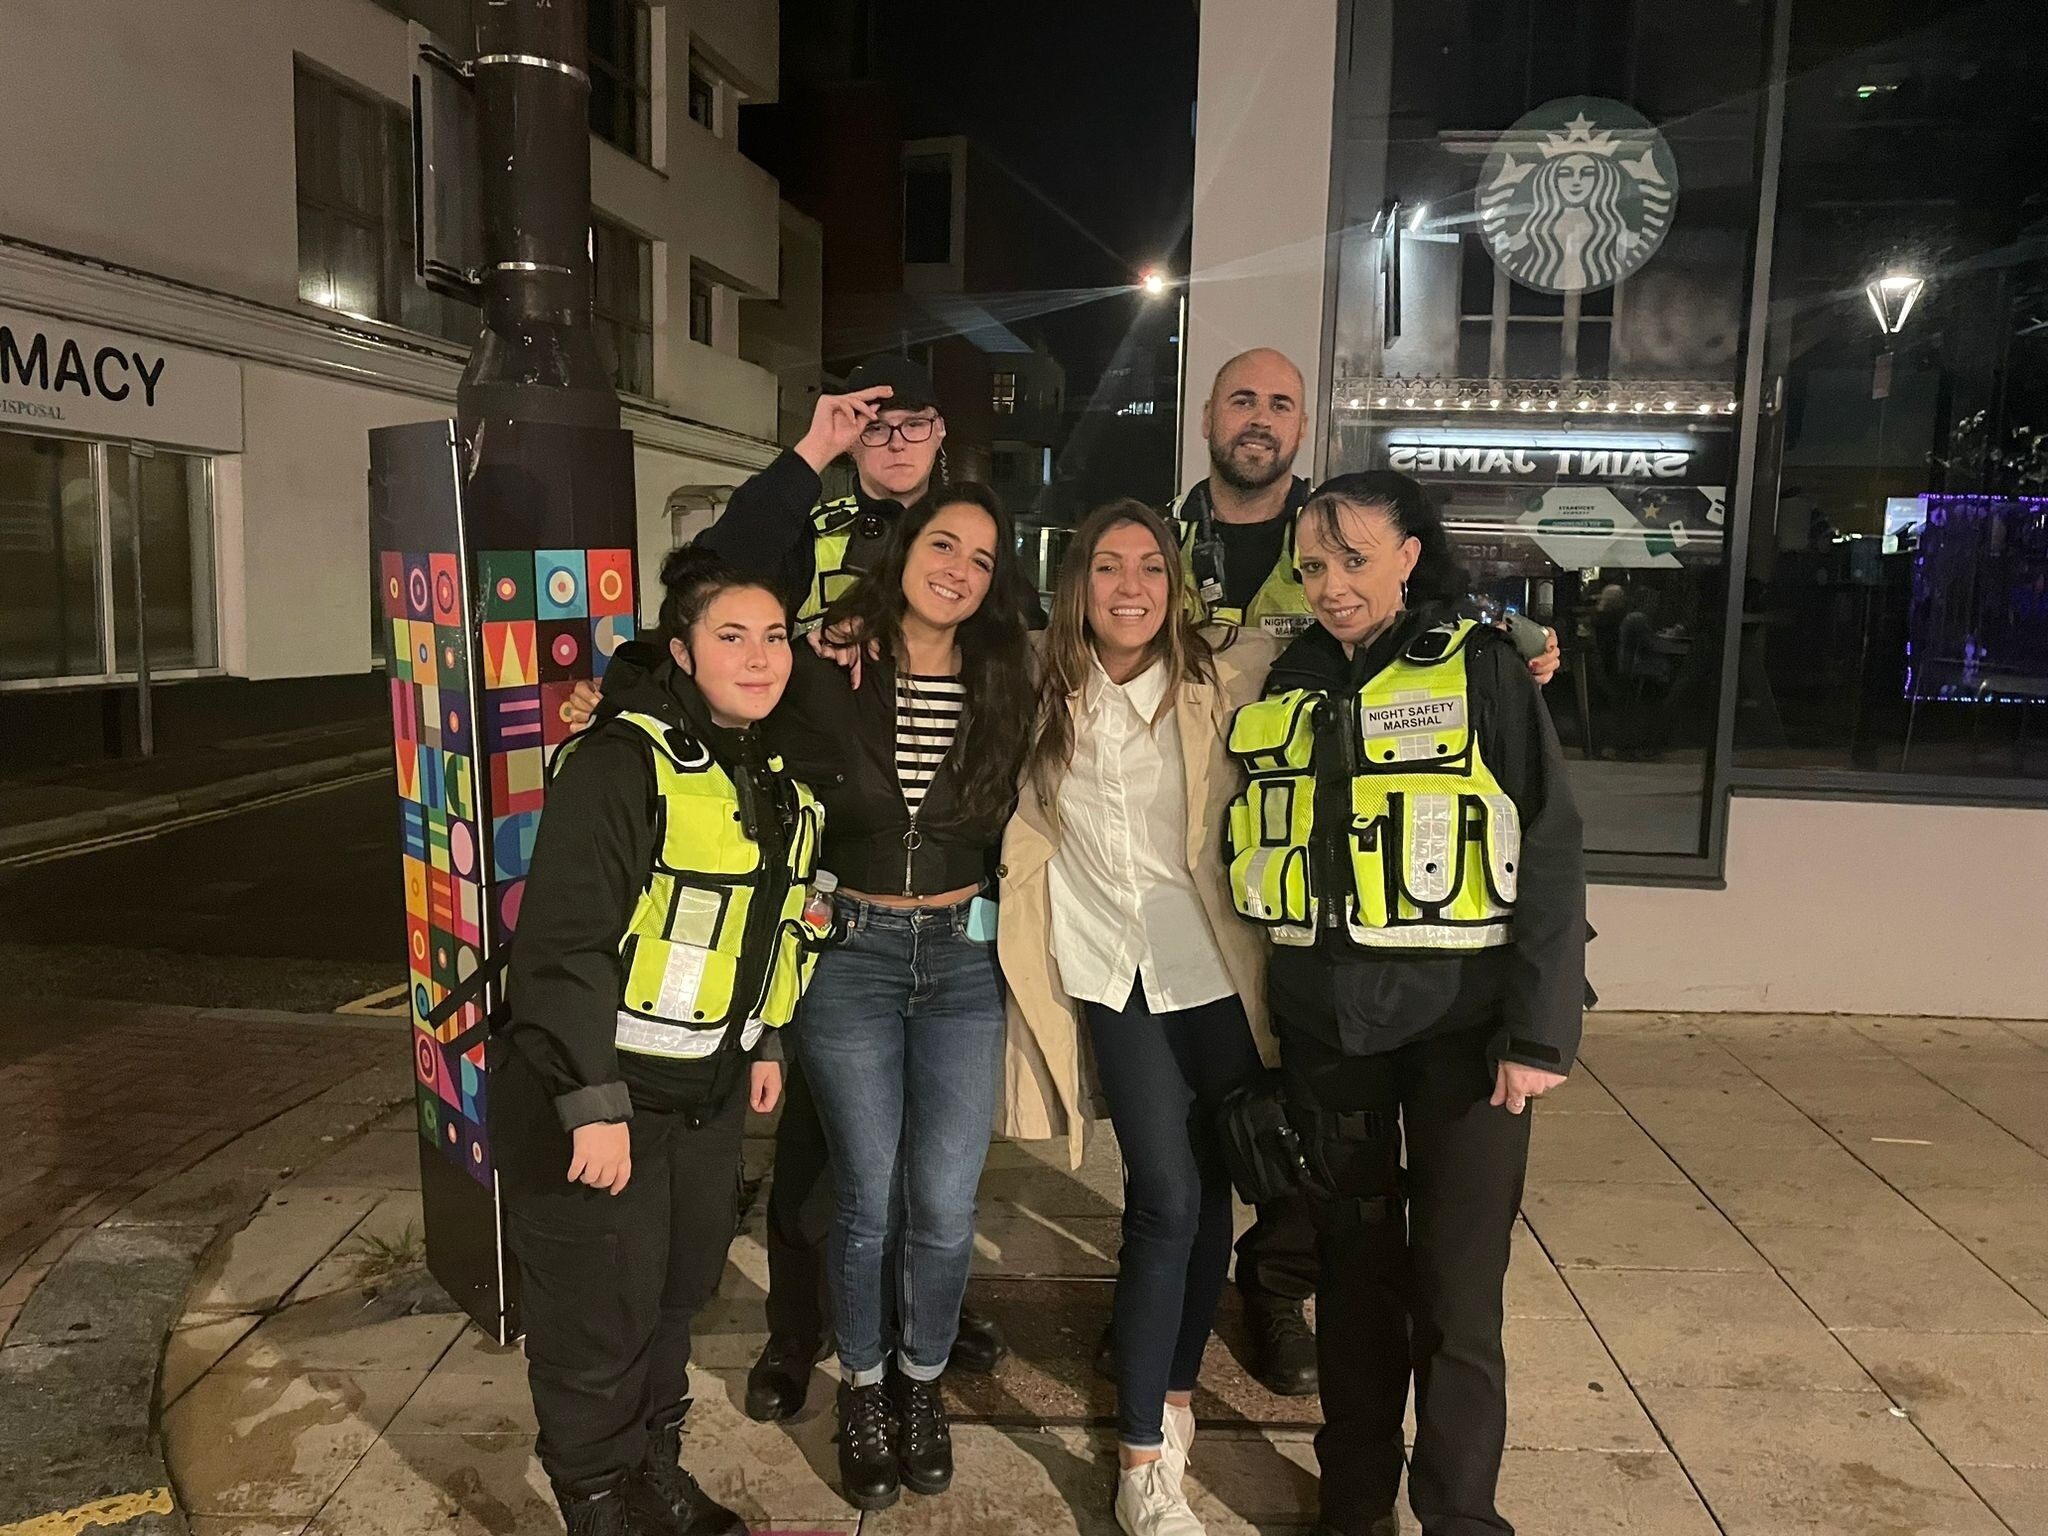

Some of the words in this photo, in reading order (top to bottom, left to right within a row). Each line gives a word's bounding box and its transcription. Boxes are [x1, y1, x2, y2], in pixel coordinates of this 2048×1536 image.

[0, 326, 165, 407] MACY
[0, 399, 66, 420] ISPOSAL
[1264, 618, 1293, 626] NIGHT
[1369, 709, 1405, 721] NIGHT
[1408, 702, 1454, 716] SAFETY
[1383, 715, 1442, 731] MARSHAL
